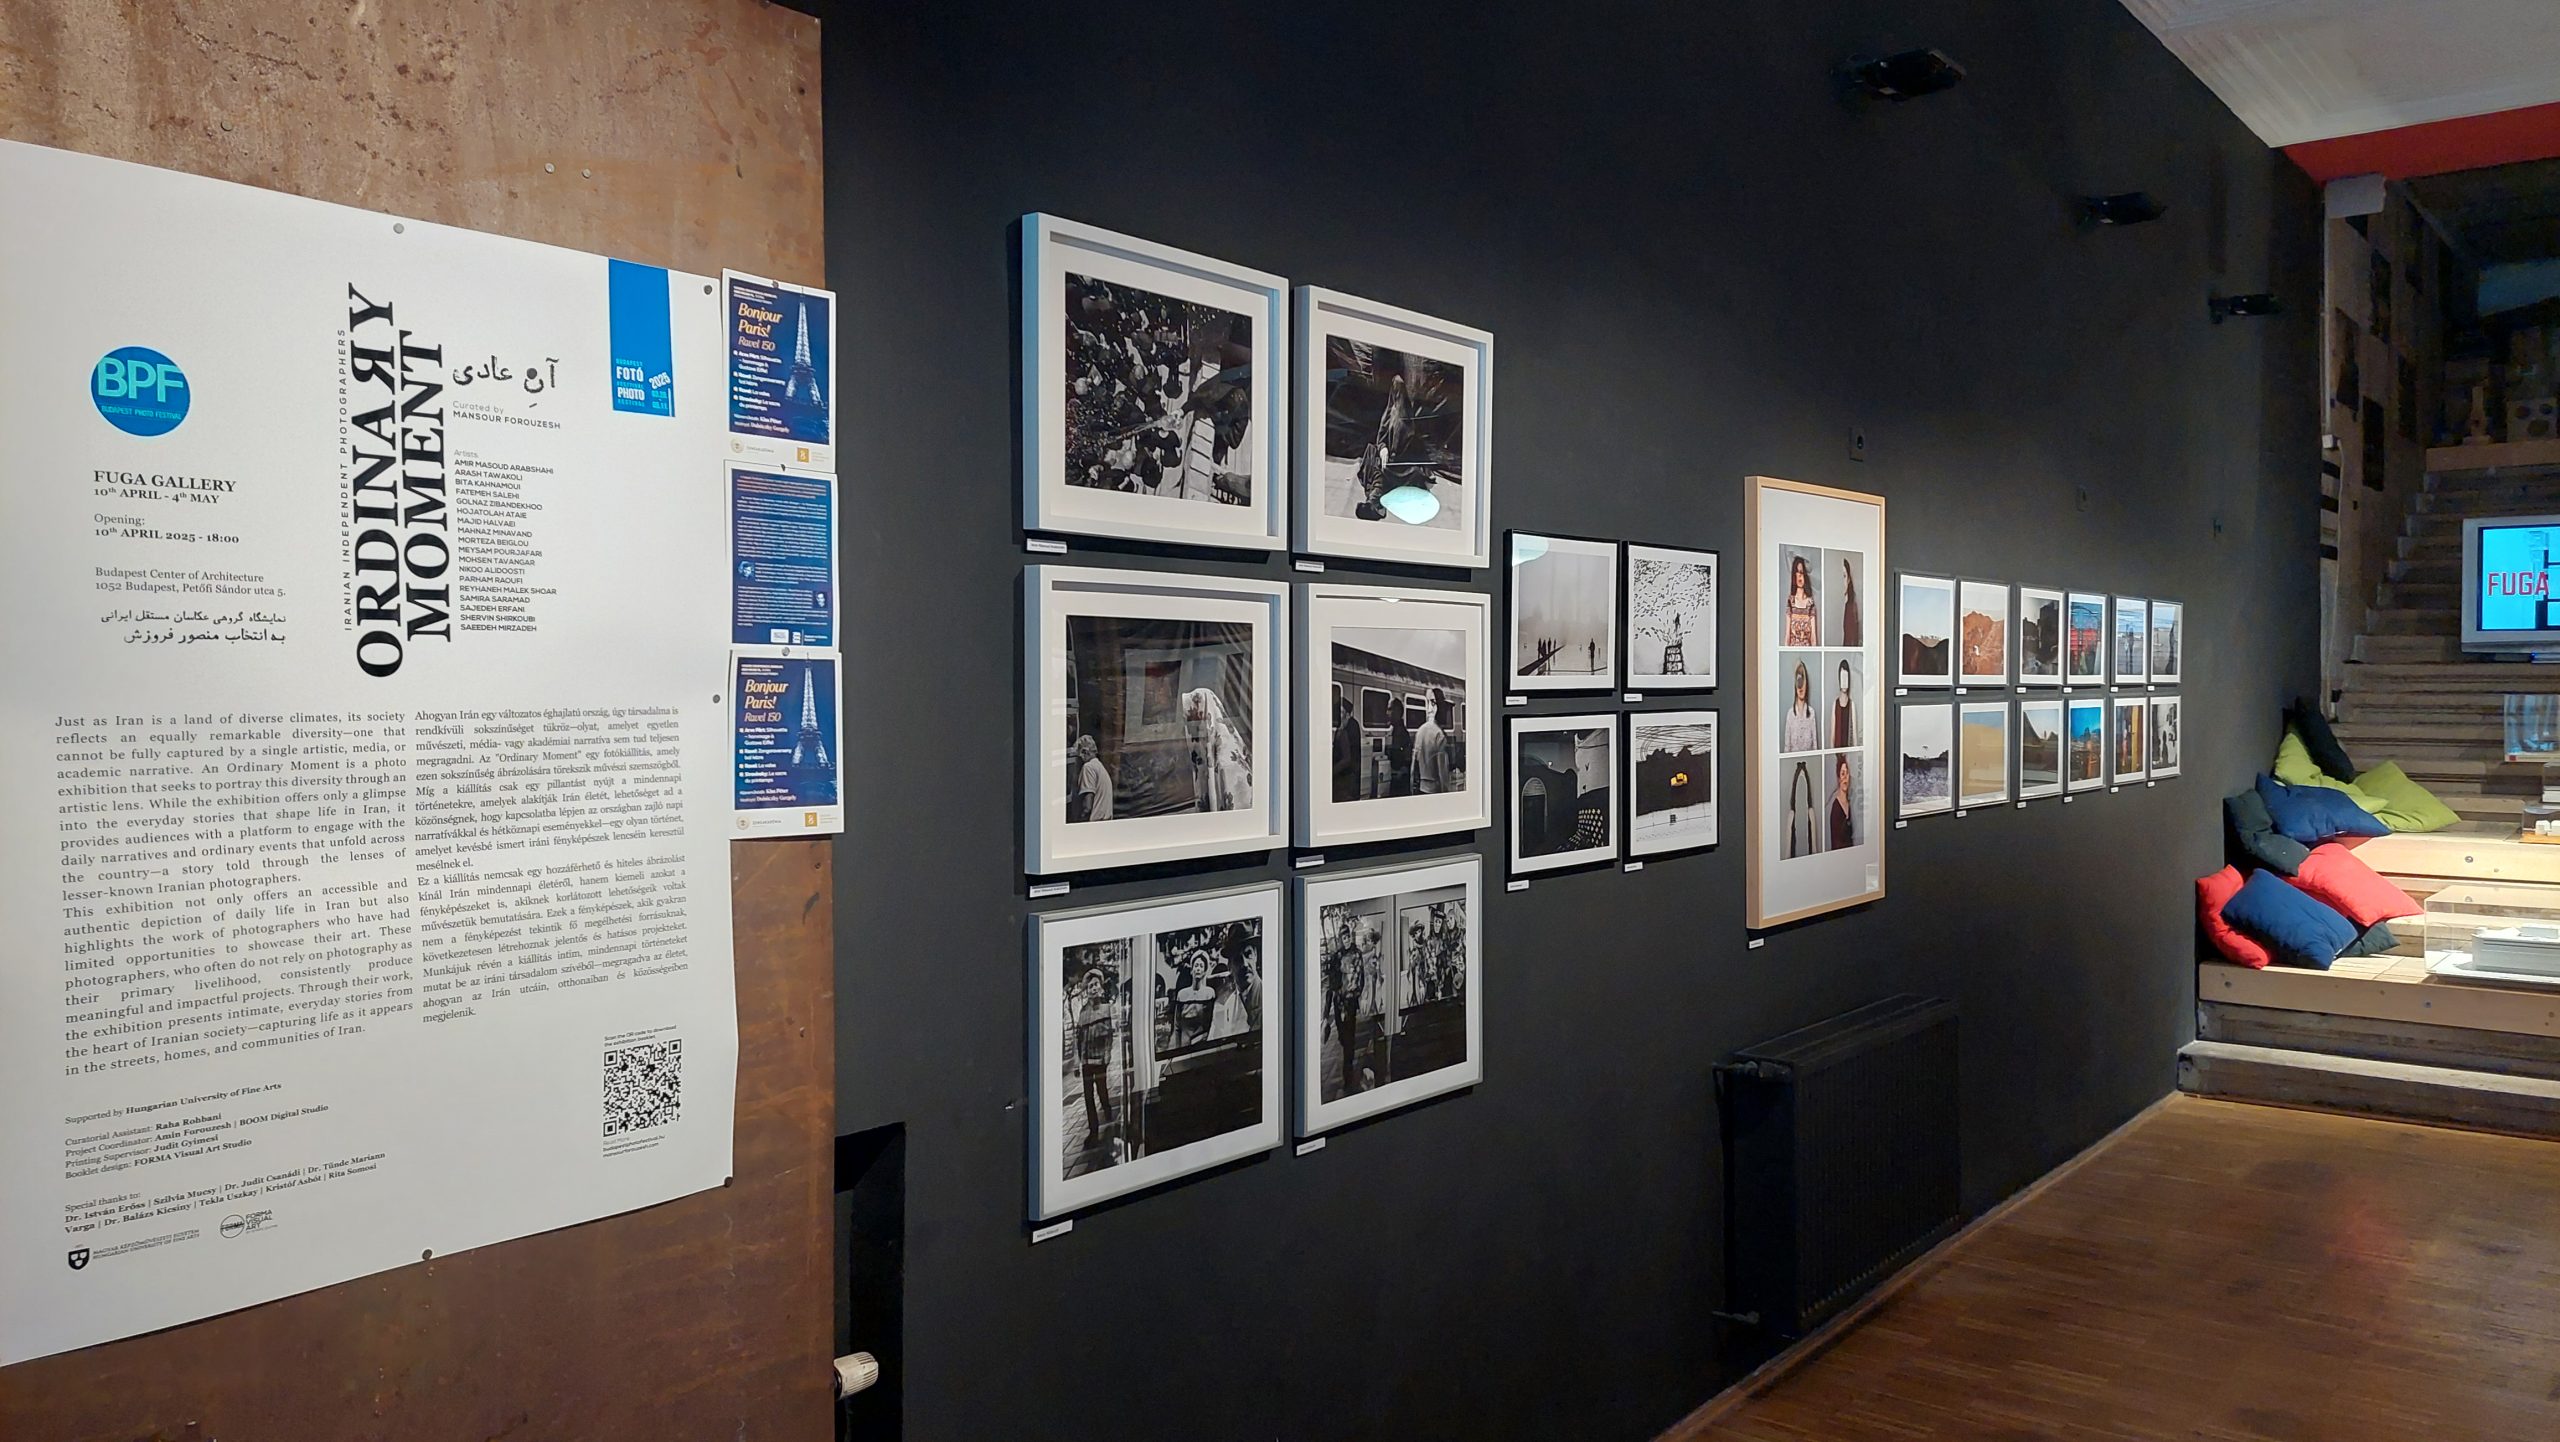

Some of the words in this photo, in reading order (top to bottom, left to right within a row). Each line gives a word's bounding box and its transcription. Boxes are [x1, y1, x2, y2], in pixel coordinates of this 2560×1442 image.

[738, 302, 783, 326] Bonjour
[738, 320, 772, 338] Paris!
[98, 357, 184, 402] BPF
[616, 366, 644, 382] FOTÓ
[648, 372, 671, 389] 2025
[337, 330, 347, 454] PHOTOGRAPHERS
[617, 387, 645, 400] PHOTO
[453, 400, 490, 412] Curated
[493, 406, 504, 415] by
[453, 410, 502, 423] MANSOUR
[504, 416, 561, 429] FOROUZESH
[454, 458, 474, 467] AMIR
[474, 460, 509, 470] MASOUD
[509, 464, 554, 474] ARABSHAHI
[93, 470, 147, 485] FUGA
[151, 474, 236, 492] GALLERY
[454, 468, 482, 477] ARASH
[483, 471, 522, 481] TAWAKOLI
[454, 478, 473, 486] BITA
[399, 330, 451, 642] MOMENT
[455, 487, 491, 497] FATEMEH
[492, 490, 519, 499] SALEHI
[119, 488, 162, 499] APRIL
[190, 493, 219, 503] MAY
[455, 497, 488, 506] GOLNAZ
[94, 513, 145, 527] Opening:
[340, 463, 350, 562] INDEPENDENT
[456, 507, 504, 517] HOJATOLAH
[505, 510, 527, 519] ATAIE
[456, 516, 482, 525] MAJID
[120, 528, 163, 539] APRIL
[165, 532, 195, 542] 2025
[207, 532, 239, 543] 18:00
[457, 526, 491, 535] MAHNAZ
[492, 528, 532, 537] MINAVAND
[457, 536, 496, 545] MORTEZA
[496, 538, 529, 547] BEIGLOU
[458, 546, 492, 554] MEYSAM
[493, 547, 542, 557] POURJAFARI
[458, 555, 492, 564] MOHSEN
[492, 557, 535, 566] TAVANGAR
[95, 566, 147, 579] Budapest
[149, 568, 186, 579] Center
[188, 569, 199, 580] of
[201, 570, 264, 582] Architecture
[458, 565, 483, 573] NIKOO
[484, 566, 525, 575] ALIDOOSTI
[458, 575, 493, 583] PARHAM
[494, 576, 523, 584] RAOUFI
[2488, 572, 2549, 596] FUGA
[95, 582, 122, 592] 1052
[125, 580, 179, 594] Budapest,
[182, 582, 212, 593] Petőfi
[215, 583, 251, 595] Sándor
[253, 586, 274, 595] utca
[277, 588, 286, 597] 5.
[459, 584, 502, 593] REYHANEH
[503, 586, 529, 594] MALEK
[530, 587, 557, 595] SHOAR
[343, 572, 352, 630] IRANIAN
[459, 594, 490, 602] SAMIRA
[491, 595, 530, 603] SARAMAD
[459, 604, 496, 612] SAJEDEH
[460, 613, 494, 621] SHERVIN
[495, 614, 535, 622] SHIRKOUBI
[460, 623, 497, 631] SAEEDEH
[498, 624, 537, 632] MIRZADEH
[744, 679, 789, 695] Bonjour
[744, 696, 776, 710] Paris!
[54, 716, 85, 726] Just
[92, 718, 107, 726] as
[115, 715, 143, 725] Iran
[151, 714, 162, 725] is
[169, 717, 176, 725] a
[184, 713, 212, 724] land
[219, 713, 233, 724] of
[238, 712, 283, 724] diverse
[289, 712, 341, 723] climates,
[347, 711, 361, 722] its
[367, 711, 405, 723] society
[56, 732, 107, 744] reflects
[120, 734, 136, 742] an
[149, 730, 197, 744] equally
[209, 728, 280, 740] remarkable
[383, 725, 405, 736] that
[56, 751, 103, 761] cannot
[109, 748, 125, 760] be
[131, 747, 161, 761] fully
[166, 745, 224, 760] captured
[229, 745, 244, 759] by
[249, 748, 256, 756] a
[261, 744, 298, 757] single
[302, 743, 347, 755] artistic,
[352, 741, 390, 753] media,
[416, 754, 474, 767] megragadni.
[478, 754, 491, 763] Az
[585, 751, 600, 760] egy
[656, 746, 680, 757] amely
[57, 766, 121, 779] academic
[129, 764, 193, 776] narrative.
[201, 763, 218, 773] An
[226, 761, 283, 773] Ordinary
[290, 760, 339, 771] Moment
[346, 758, 355, 768] is
[361, 760, 368, 768] a
[374, 756, 406, 770] photo
[64, 1109, 111, 1124] Supported
[112, 1108, 123, 1117] by
[125, 1100, 178, 1114] Hungarian
[180, 1091, 228, 1105] University
[229, 1088, 240, 1097] of
[241, 1086, 261, 1095] Fine
[262, 1083, 281, 1091] Arts
